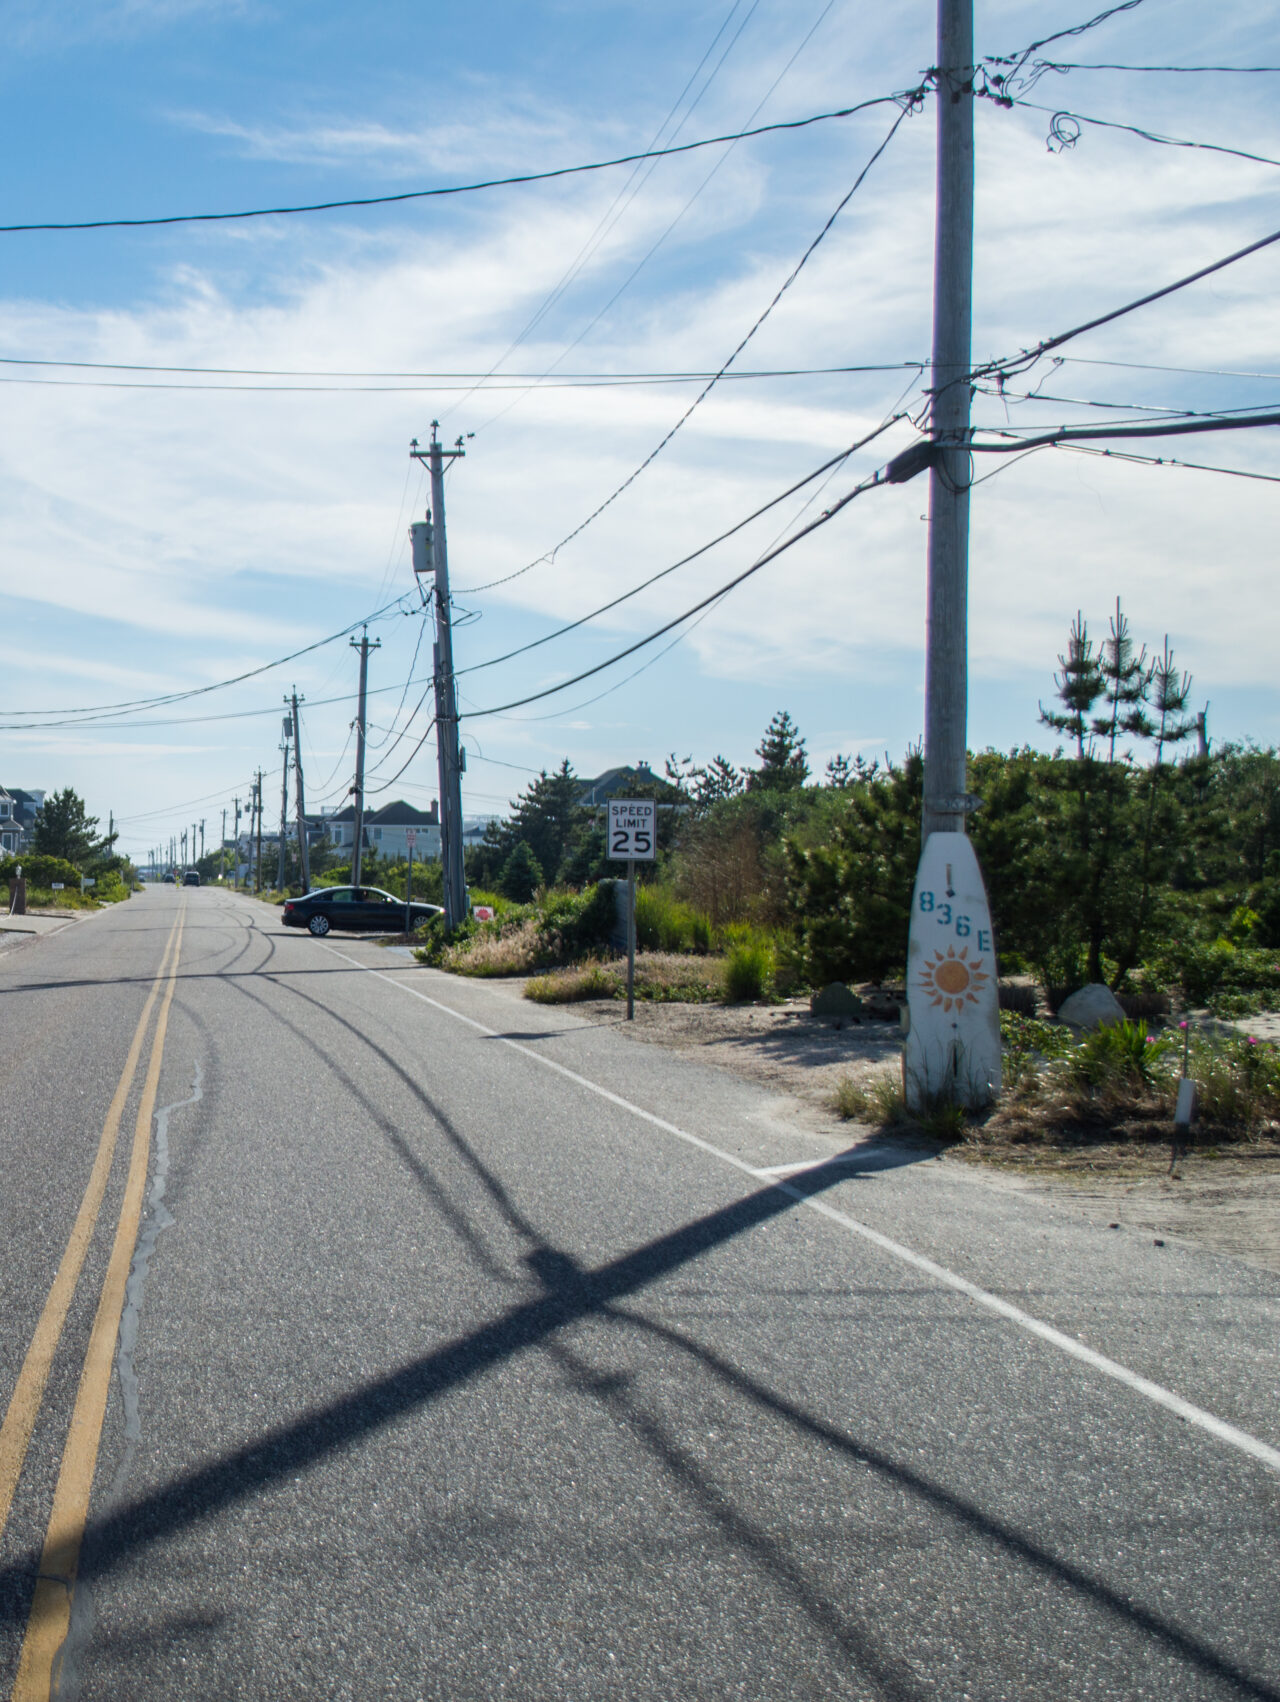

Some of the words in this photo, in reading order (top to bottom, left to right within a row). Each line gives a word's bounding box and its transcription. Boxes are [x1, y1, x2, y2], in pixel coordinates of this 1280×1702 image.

[612, 806, 652, 816] SPEED
[616, 819, 647, 828] LIMIT
[612, 831, 651, 853] 25
